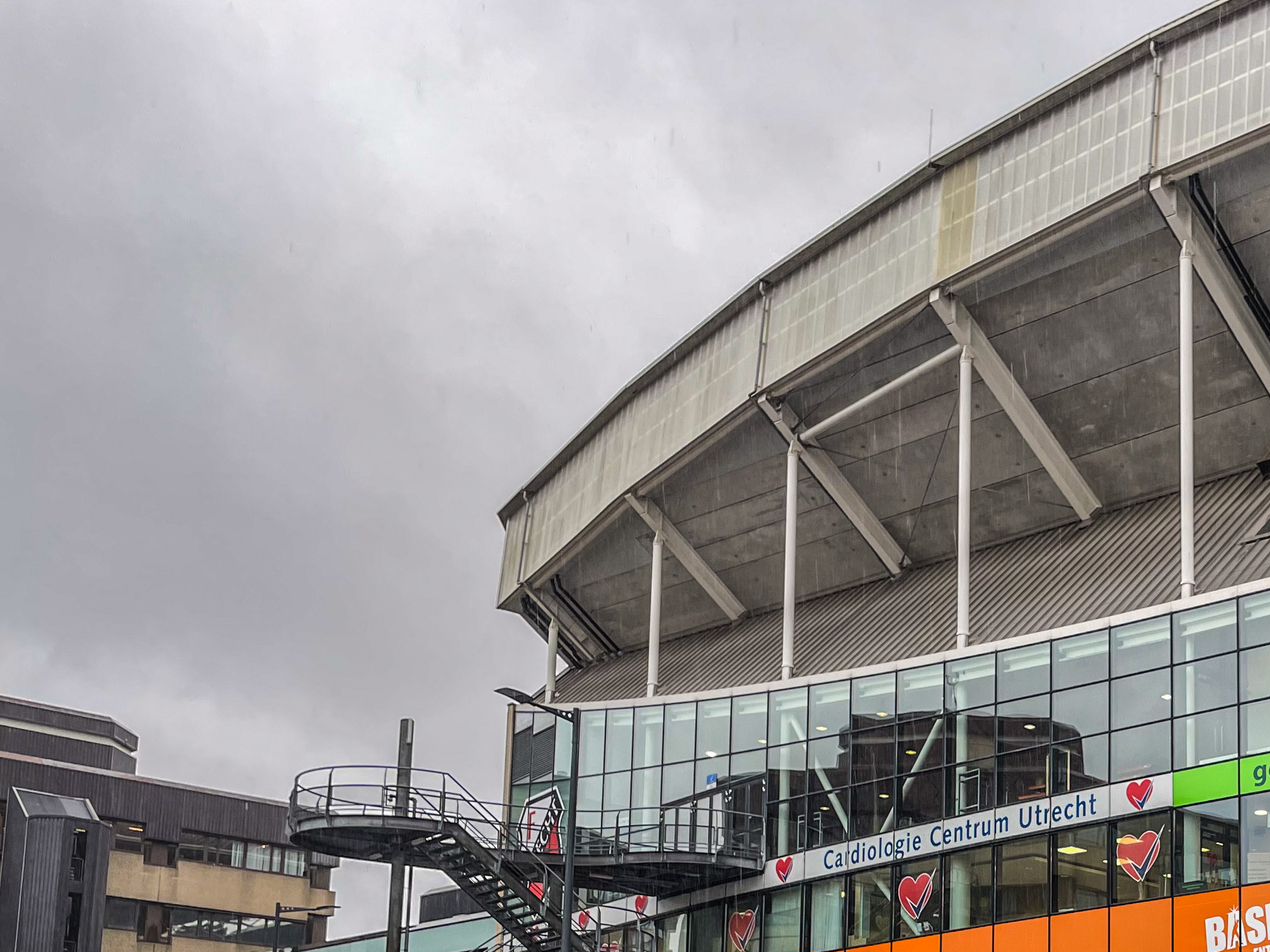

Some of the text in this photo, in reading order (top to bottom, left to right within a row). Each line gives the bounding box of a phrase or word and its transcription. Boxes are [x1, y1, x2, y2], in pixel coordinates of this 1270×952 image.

[823, 793, 1097, 870] Cardiologie Centrum Utrecht
